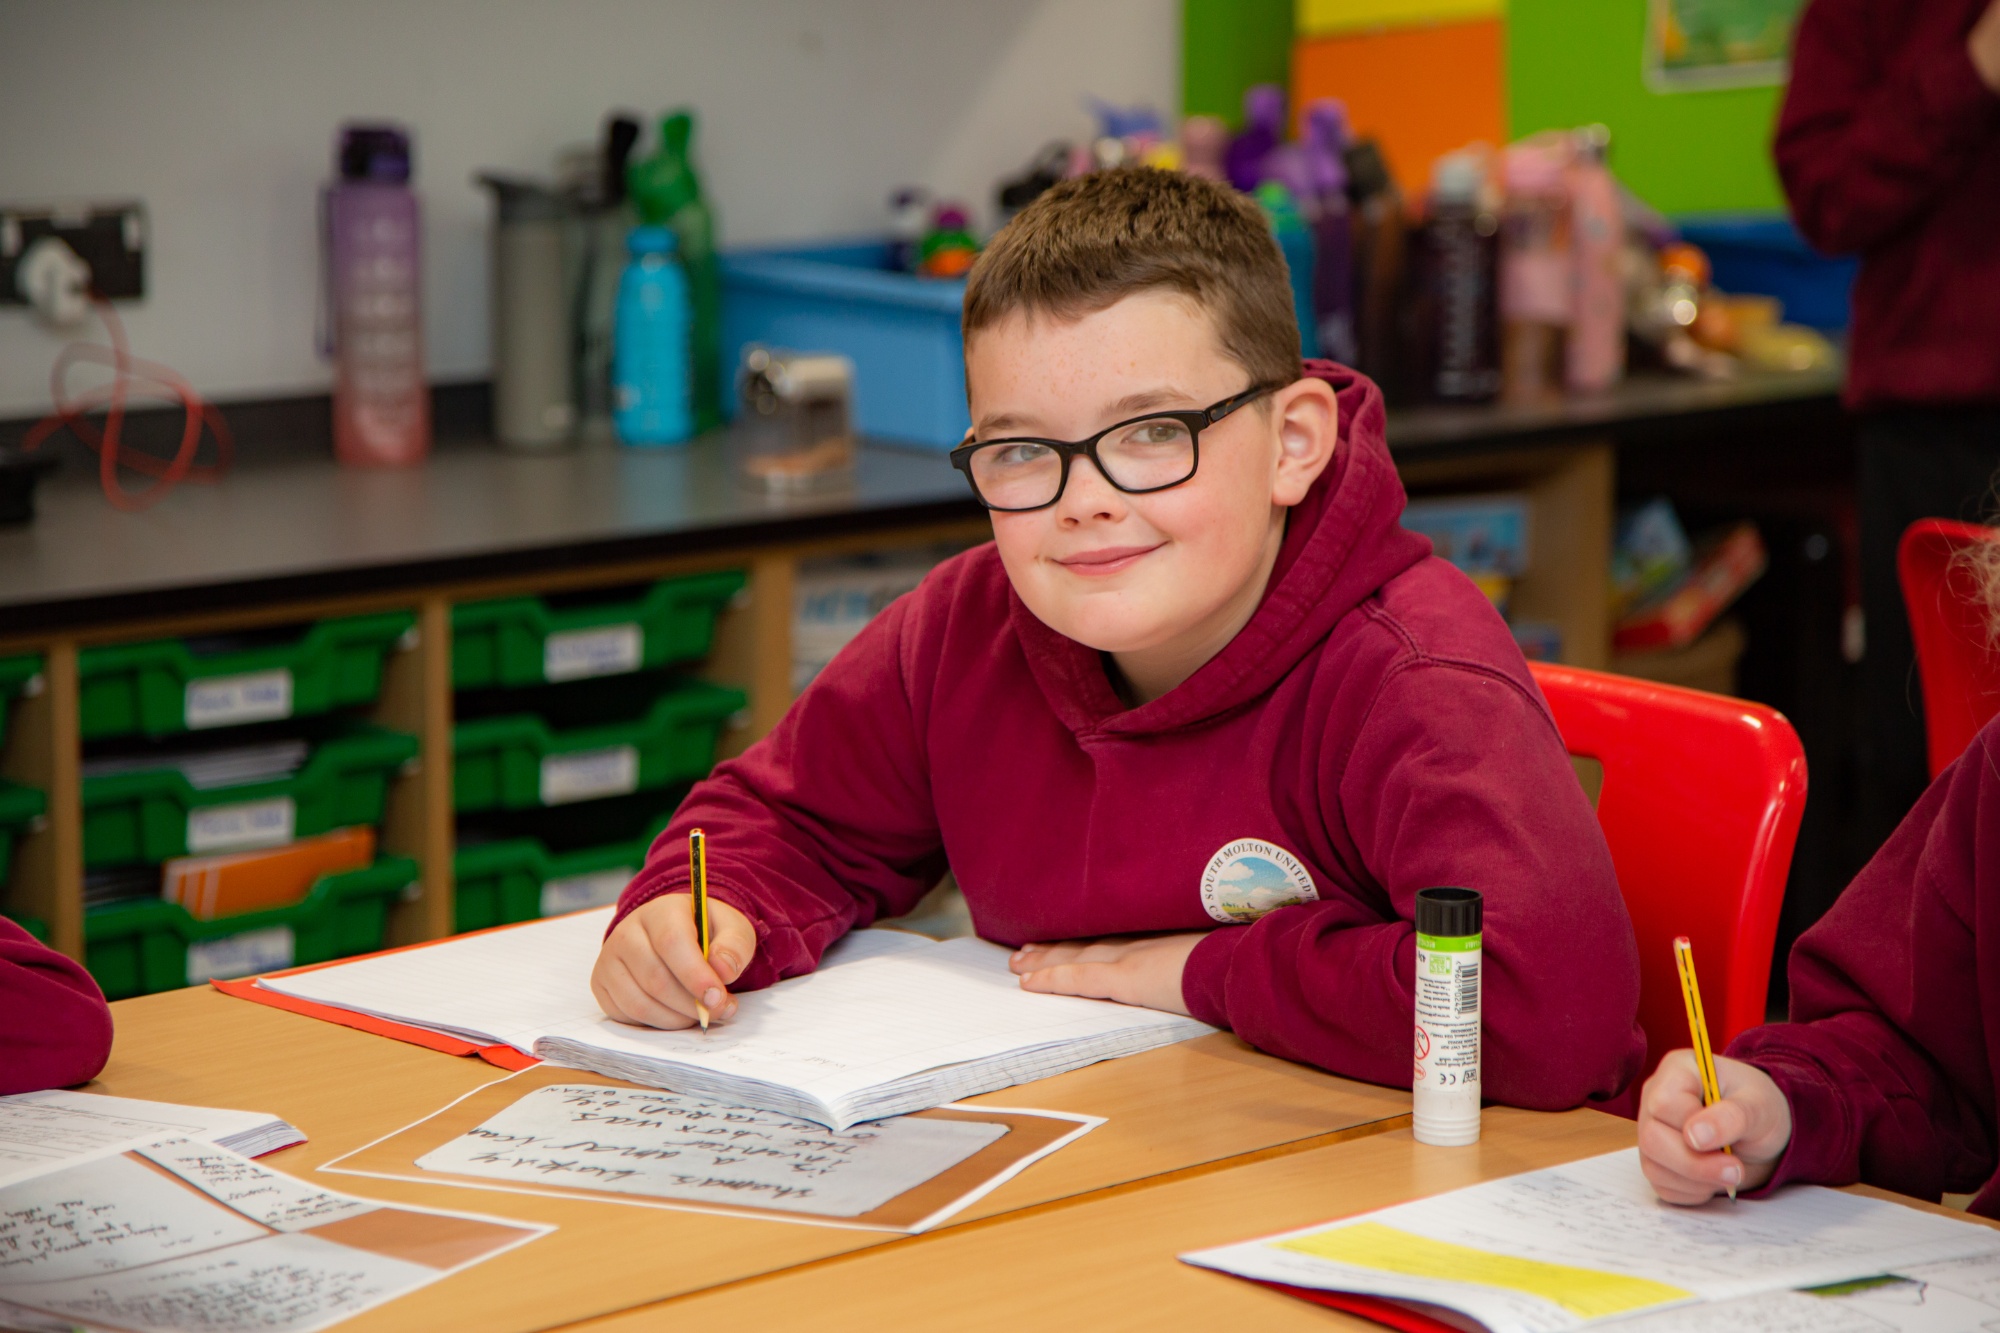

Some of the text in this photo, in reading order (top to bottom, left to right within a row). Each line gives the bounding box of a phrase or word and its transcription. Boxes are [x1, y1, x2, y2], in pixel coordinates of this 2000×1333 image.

[1204, 842, 1312, 901] SOUTH MOLTON UNITED
[793, 1139, 858, 1155] The
[712, 1156, 746, 1166] a
